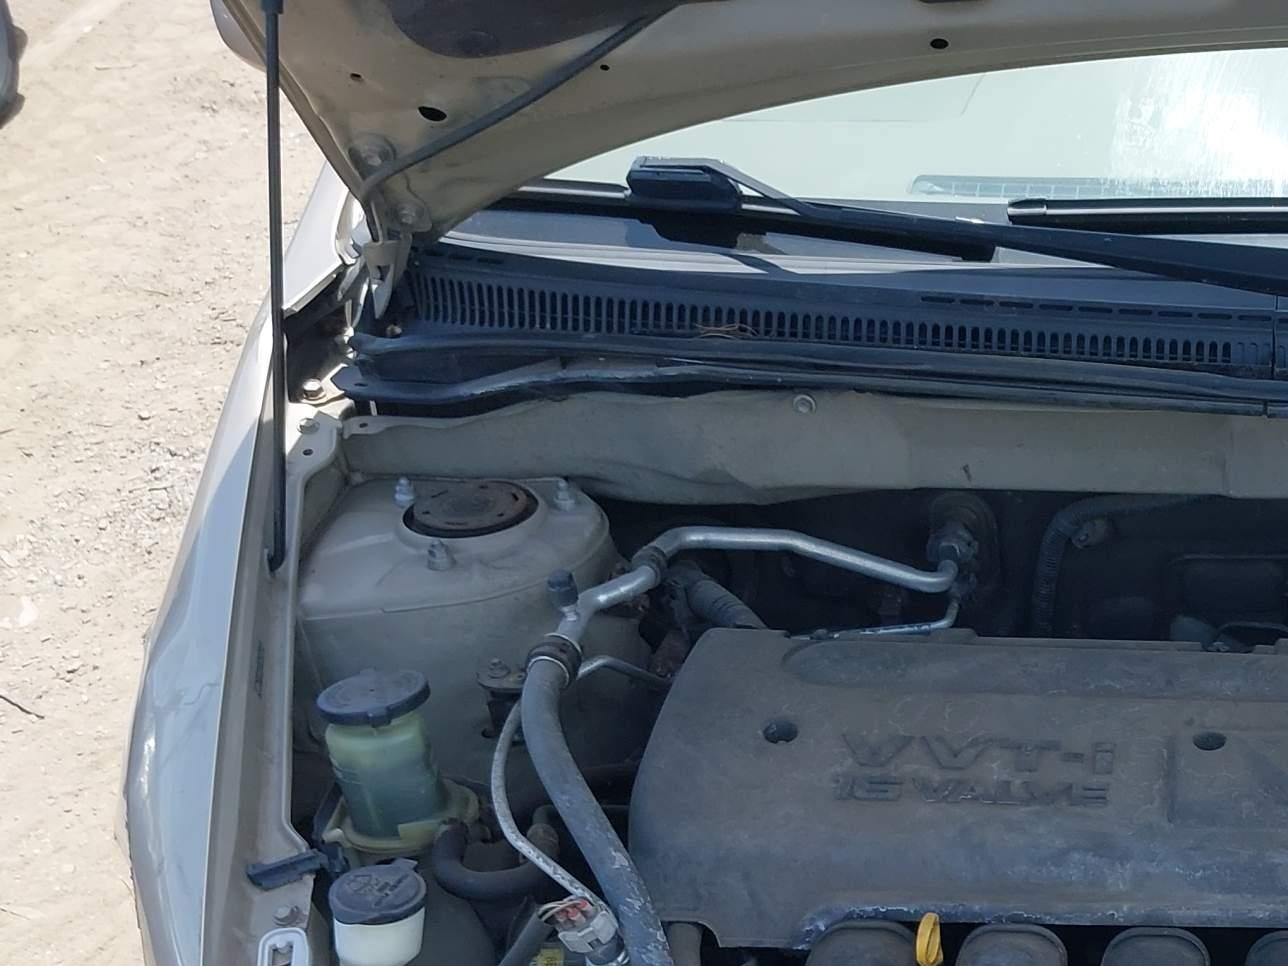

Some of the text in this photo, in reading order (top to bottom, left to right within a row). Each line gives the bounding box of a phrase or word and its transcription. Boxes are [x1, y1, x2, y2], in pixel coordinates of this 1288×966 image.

[841, 733, 1116, 775] VVT-i
[832, 775, 1110, 806] 16 VALVE
